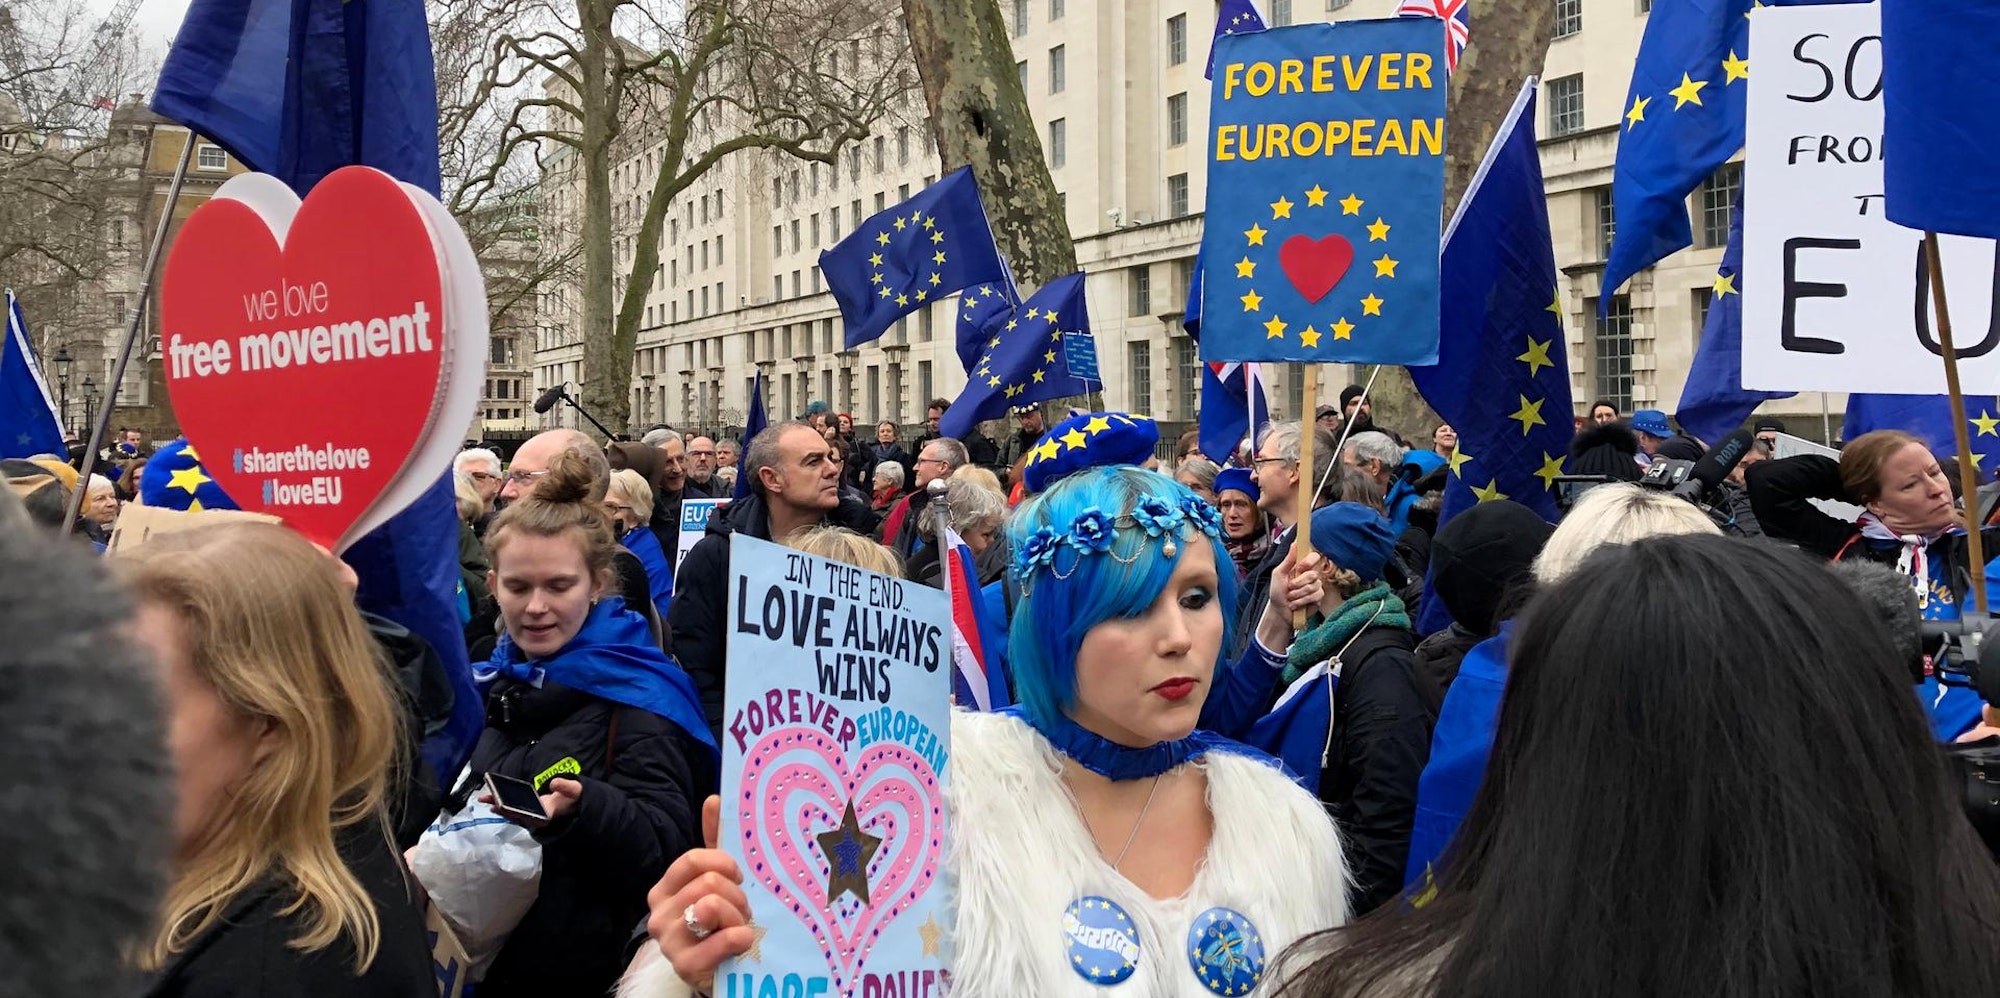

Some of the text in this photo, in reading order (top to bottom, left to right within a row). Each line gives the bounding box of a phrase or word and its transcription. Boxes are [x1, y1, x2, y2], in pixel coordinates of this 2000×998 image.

[1224, 52, 1433, 100] FOREVER
[1216, 117, 1445, 161] EUROPEAN
[1788, 134, 1885, 165] FRO
[243, 277, 329, 322] we love
[1781, 236, 2000, 360] EU
[169, 300, 433, 380] free movement
[233, 442, 371, 474] #sharethelove
[262, 476, 343, 506] #loveEU
[684, 505, 705, 523] EU
[784, 554, 813, 589] IN
[825, 561, 862, 601] THE
[737, 574, 943, 673] LOVE ALWAYS
[815, 649, 892, 704] WINS
[729, 688, 949, 779] FOREVER EUROPEAN
